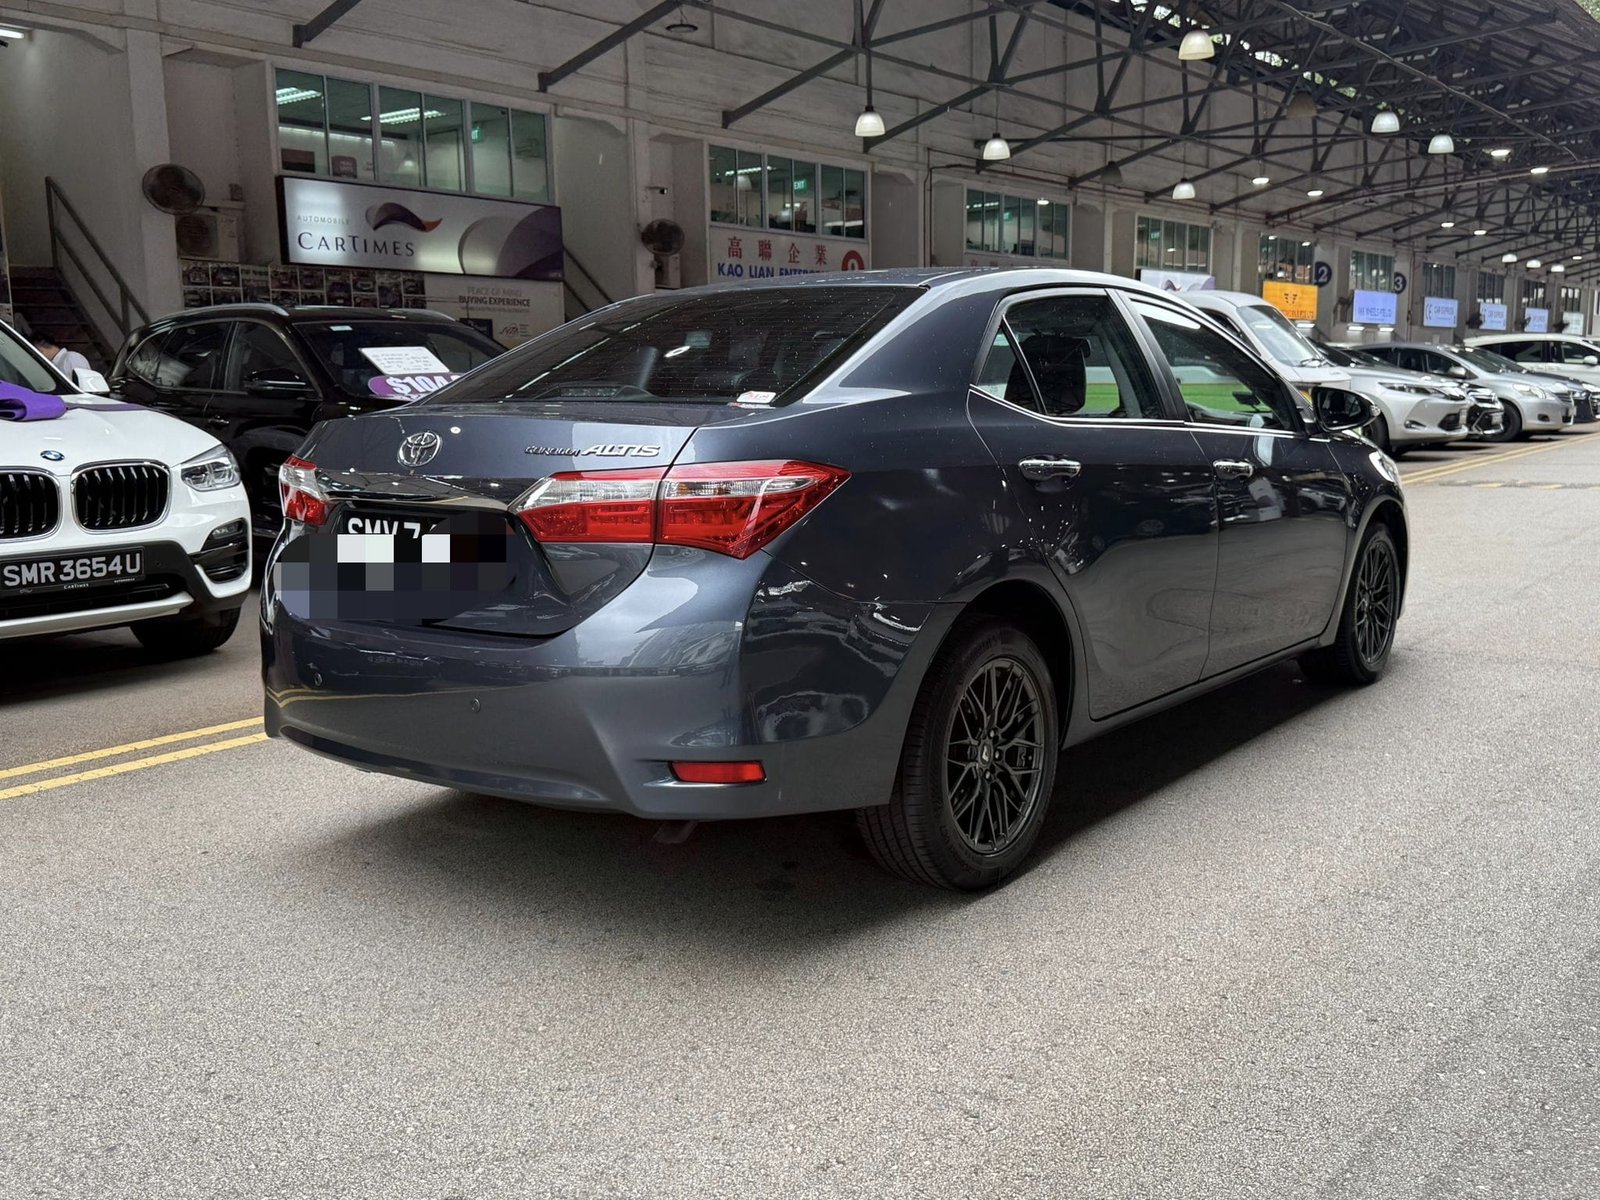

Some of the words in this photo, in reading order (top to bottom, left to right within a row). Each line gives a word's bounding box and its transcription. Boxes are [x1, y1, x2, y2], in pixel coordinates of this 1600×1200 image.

[793, 179, 805, 190] EXIT
[297, 215, 350, 225] AUTOMOBILE
[728, 235, 827, 266] 高聯企業
[717, 262, 744, 278] KAO
[749, 264, 775, 279] LIAN
[1318, 265, 1329, 283] 2
[1394, 276, 1403, 290] 3
[459, 296, 488, 305] BUYING
[489, 297, 530, 307] EXPERIENCE
[581, 444, 661, 458] ALTIS
[3, 561, 56, 587] SMR
